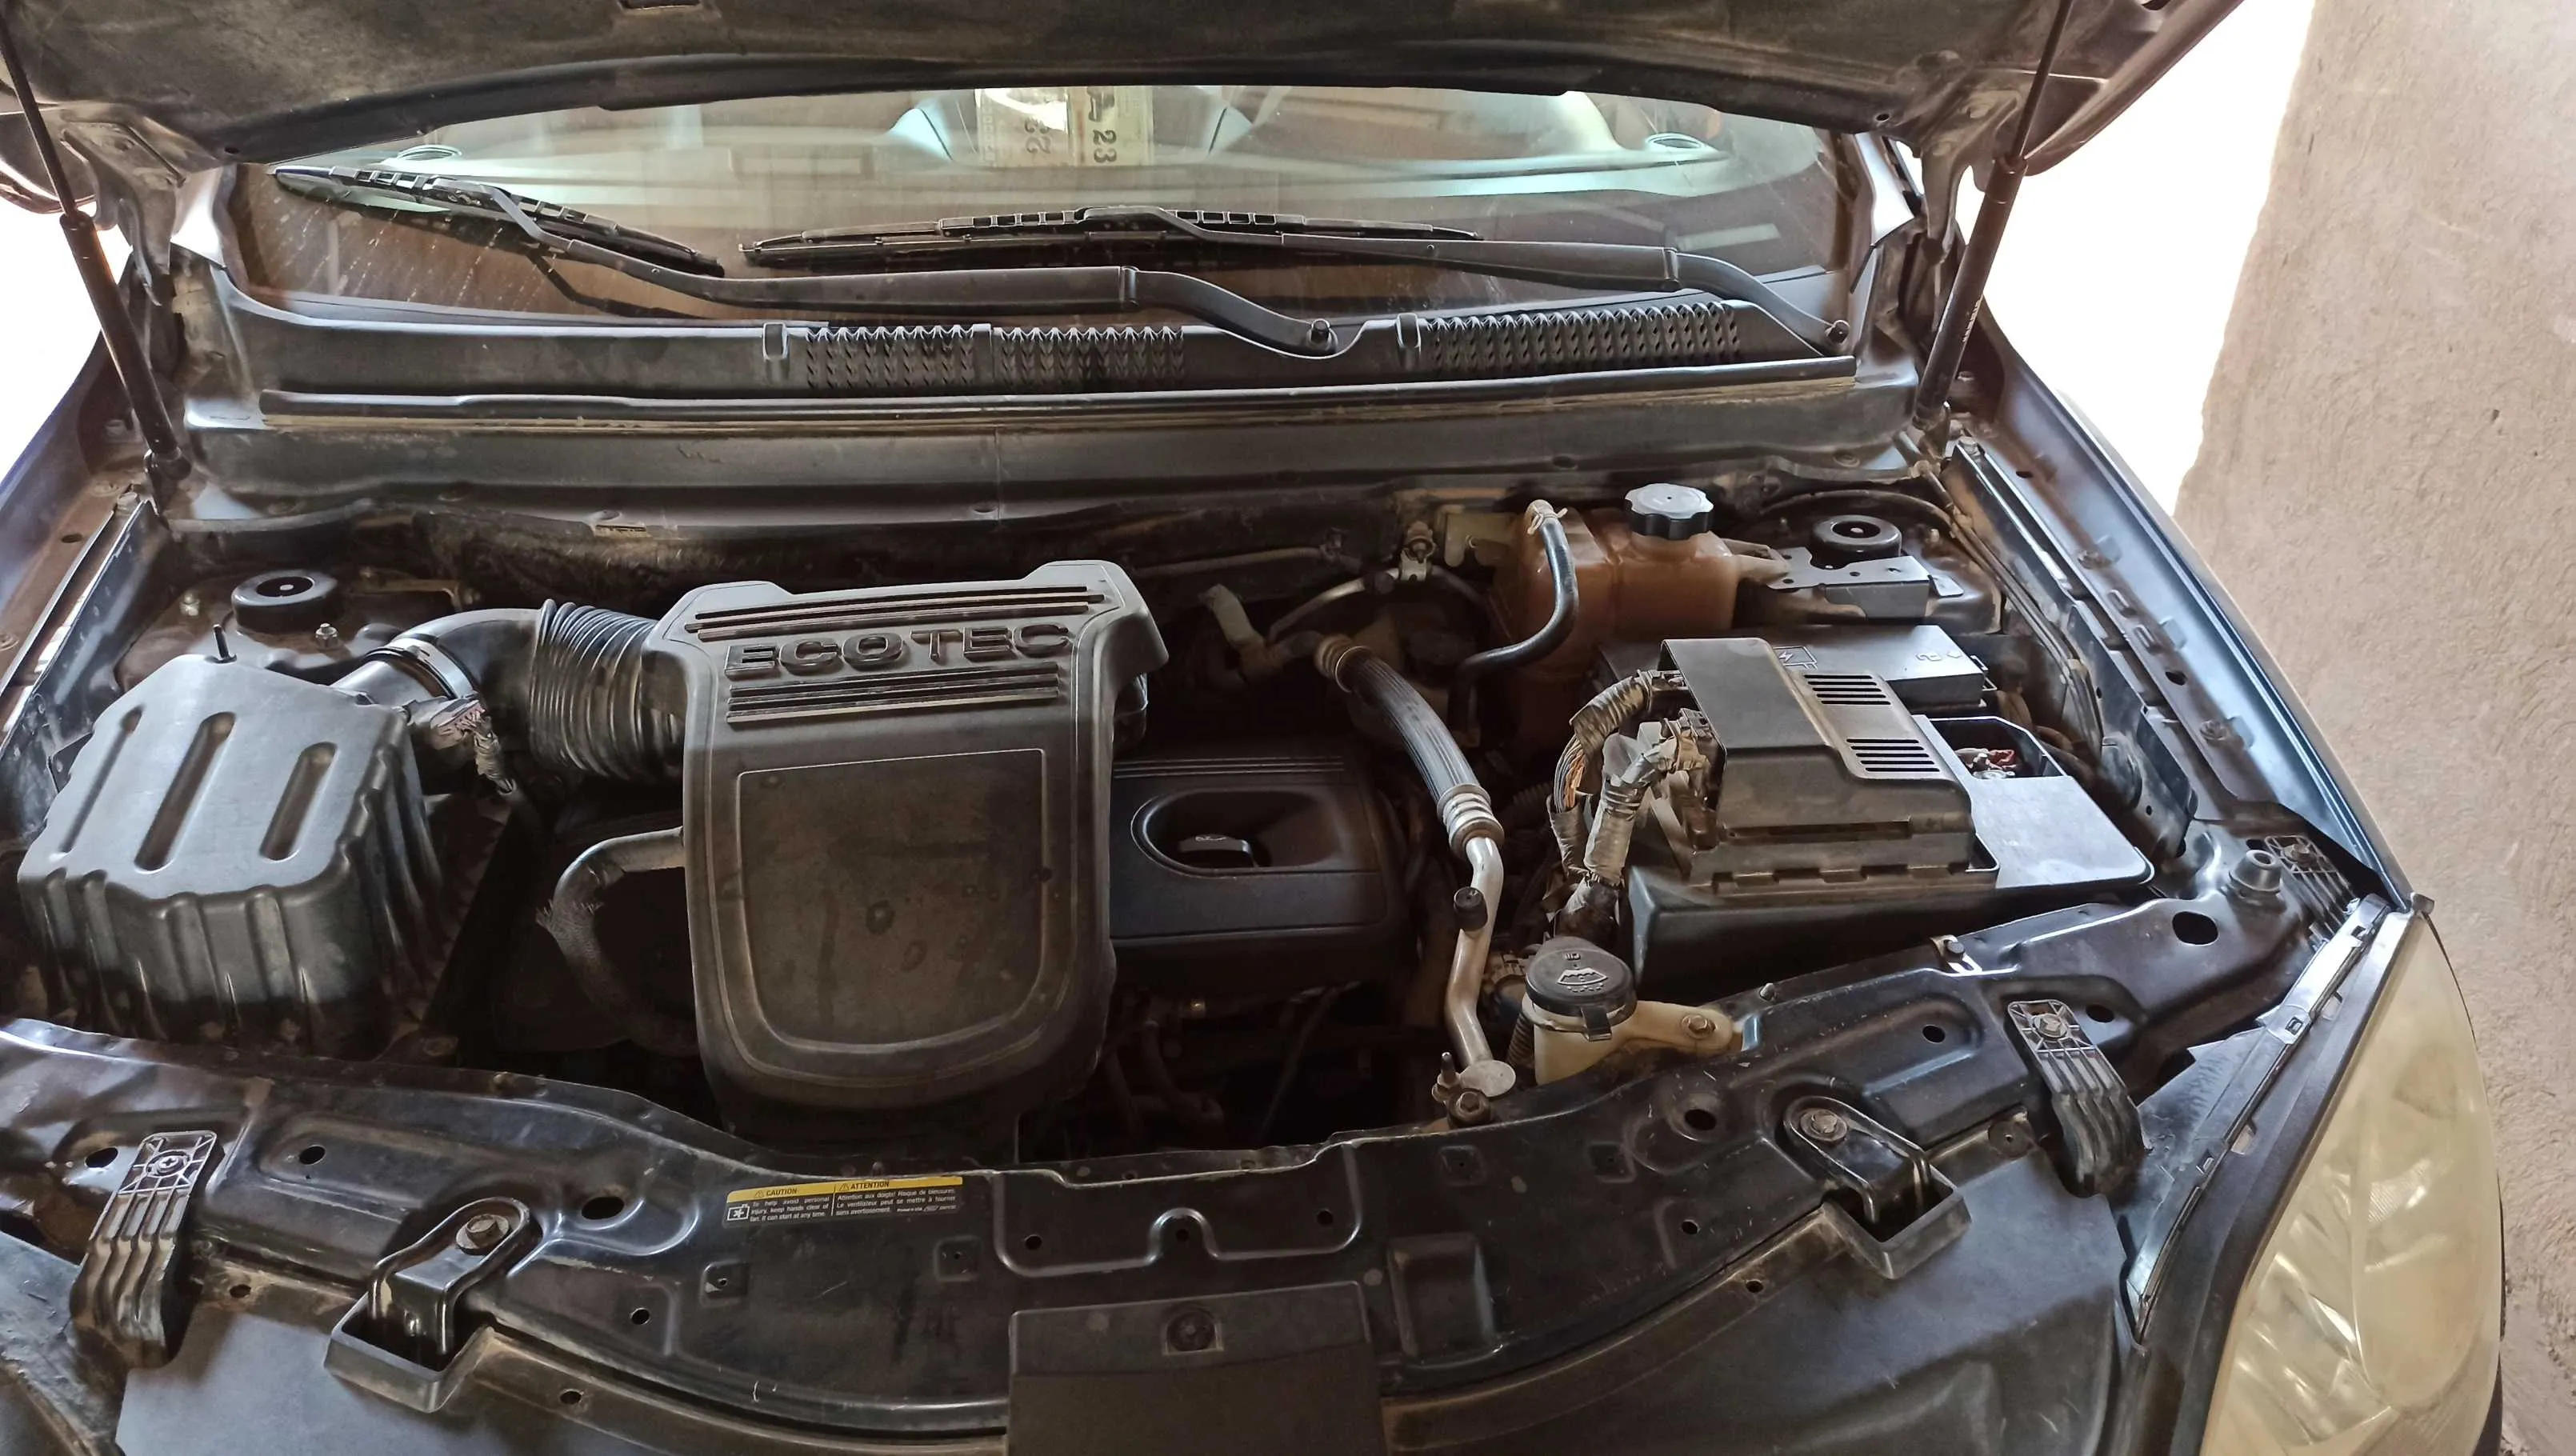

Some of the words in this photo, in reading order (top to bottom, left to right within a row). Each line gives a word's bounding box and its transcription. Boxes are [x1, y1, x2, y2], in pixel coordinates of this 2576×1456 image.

[1093, 130, 1117, 163] 23
[725, 623, 1070, 676] ECOTEC
[850, 1182, 890, 1190] ATTENTION
